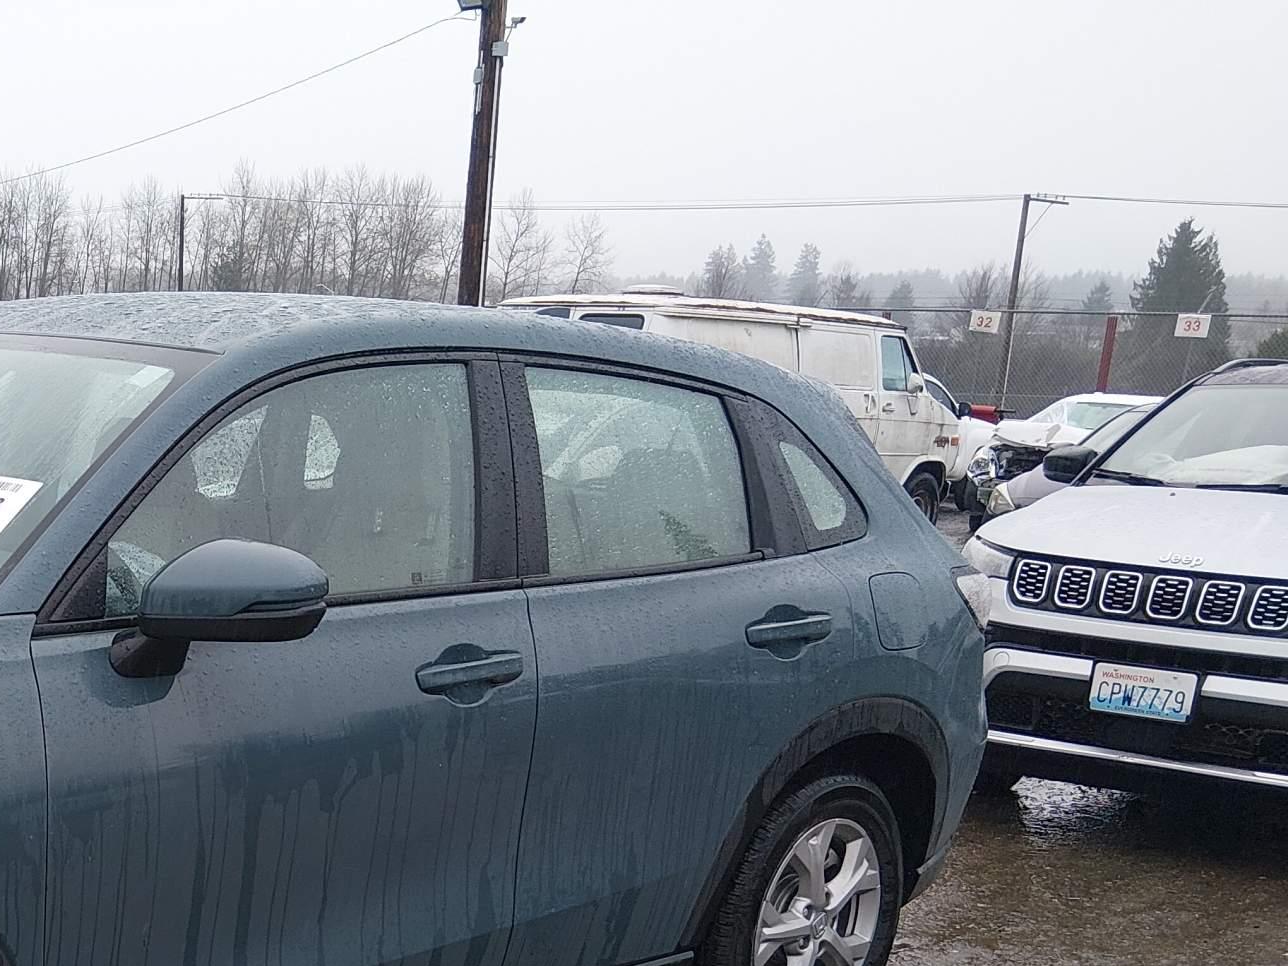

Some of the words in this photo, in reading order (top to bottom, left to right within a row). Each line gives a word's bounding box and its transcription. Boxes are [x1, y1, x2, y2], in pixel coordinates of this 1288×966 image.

[977, 316, 993, 328] 32
[1183, 320, 1201, 332] 33
[1158, 552, 1204, 568] Jeep
[1101, 670, 1154, 683] WASHINGTON
[1097, 681, 1186, 713] CPW7779
